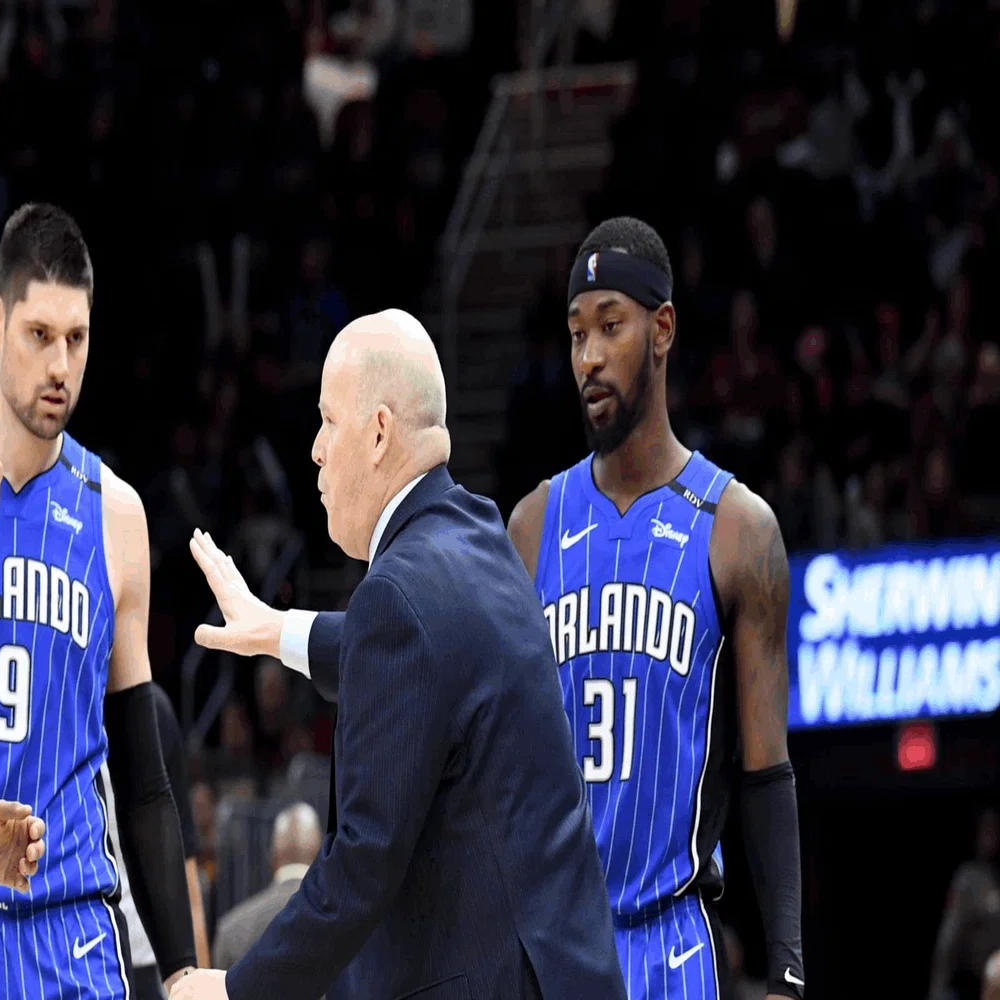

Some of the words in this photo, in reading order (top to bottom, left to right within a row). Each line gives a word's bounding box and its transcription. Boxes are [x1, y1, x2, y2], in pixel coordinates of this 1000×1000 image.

[683, 488, 704, 509] RDV
[650, 518, 690, 549] Disney
[582, 677, 638, 783] 31
